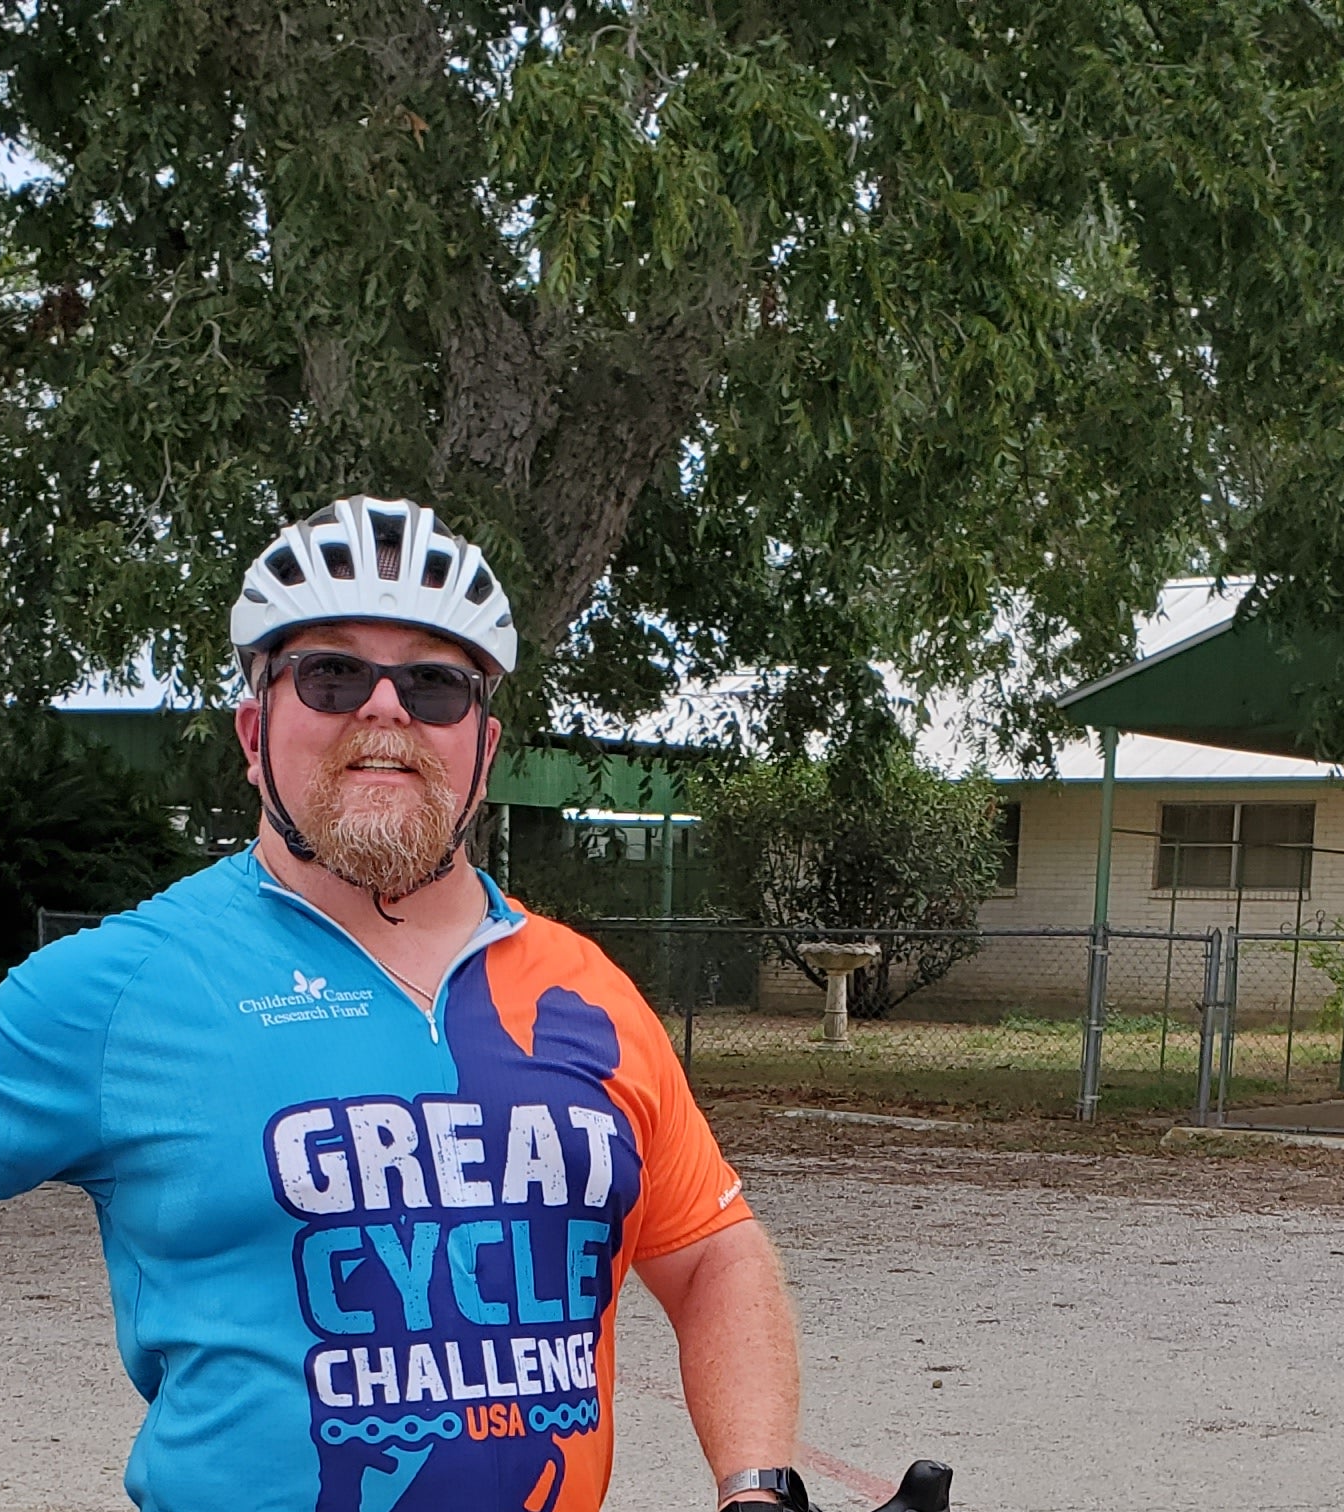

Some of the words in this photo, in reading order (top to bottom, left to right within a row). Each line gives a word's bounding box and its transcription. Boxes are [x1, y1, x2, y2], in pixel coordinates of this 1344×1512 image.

[260, 1006, 329, 1027] Research
[323, 989, 374, 1002] Cancer
[273, 1102, 618, 1214] GREAT
[302, 1220, 611, 1334] CYCLE
[313, 1332, 597, 1407] CHALLENGE
[465, 1402, 526, 1441] USA
